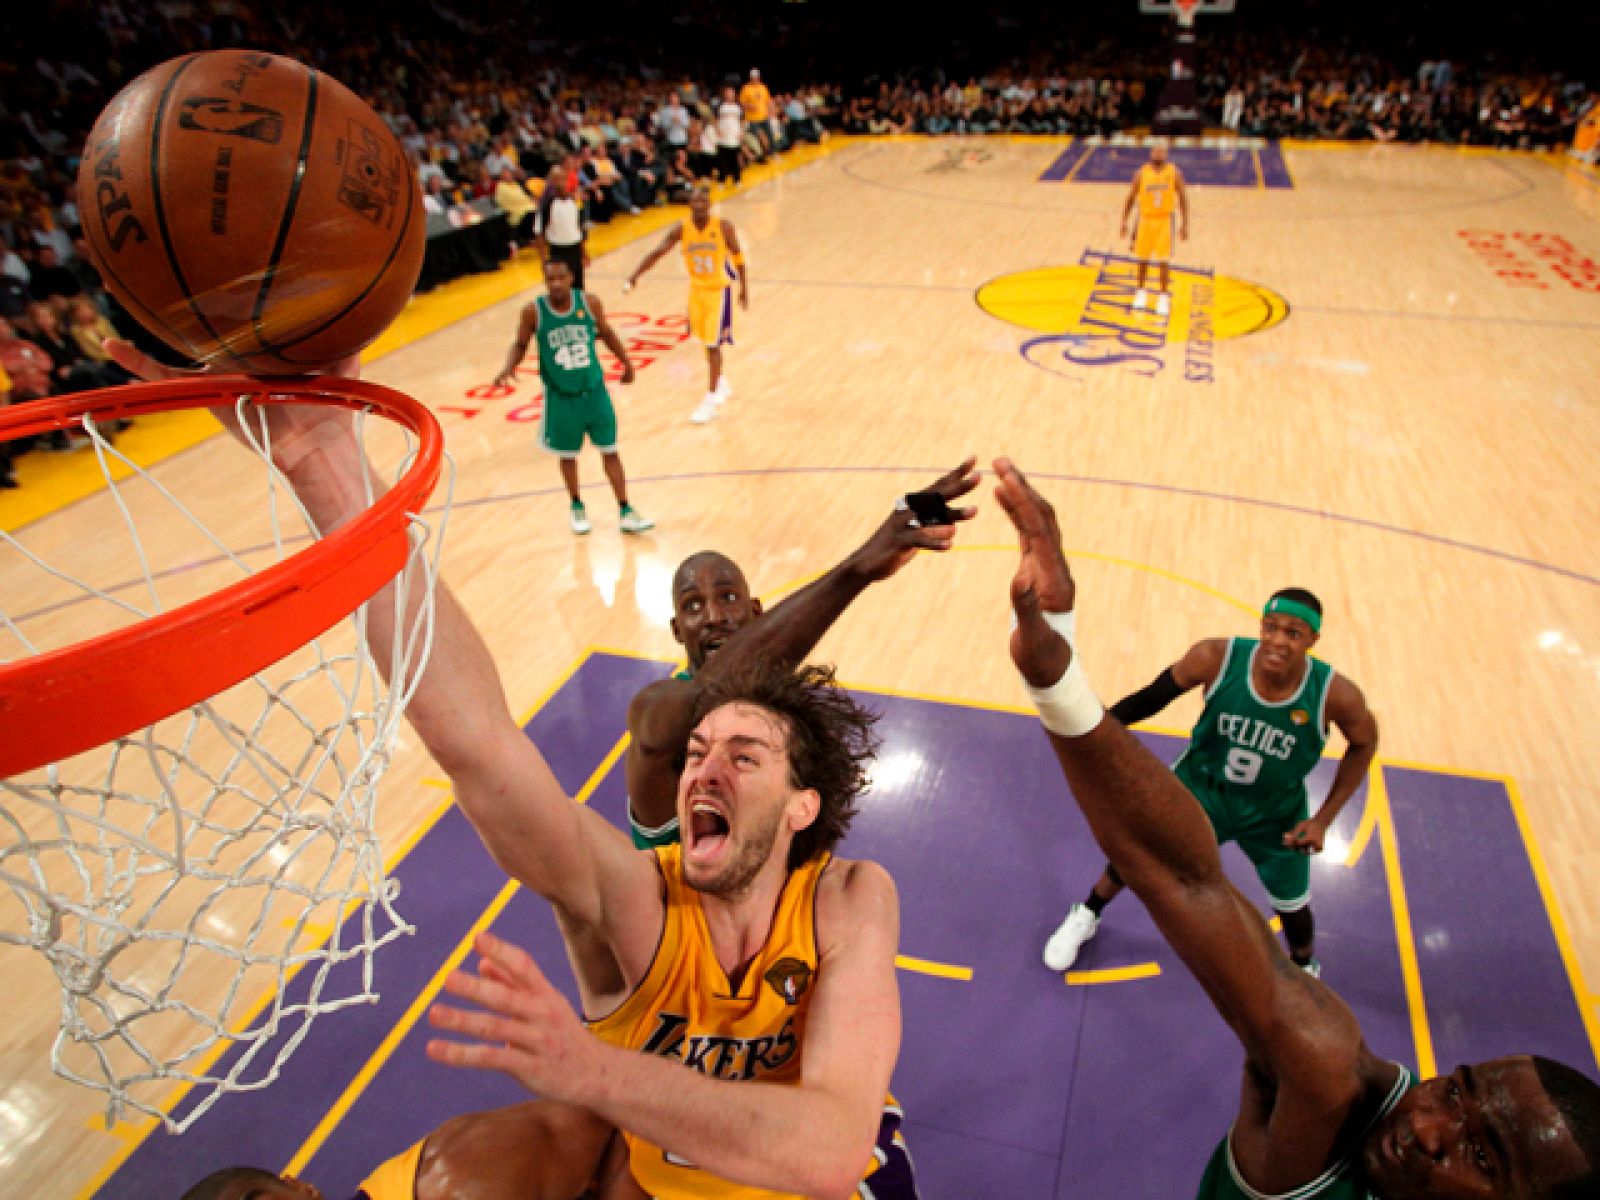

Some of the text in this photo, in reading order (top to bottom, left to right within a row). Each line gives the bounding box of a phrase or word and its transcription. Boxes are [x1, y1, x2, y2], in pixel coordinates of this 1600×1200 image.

[554, 344, 591, 370] 42
[1218, 713, 1296, 760] CELTICS
[1224, 747, 1263, 784] 9
[640, 1011, 797, 1081] LAKERS
